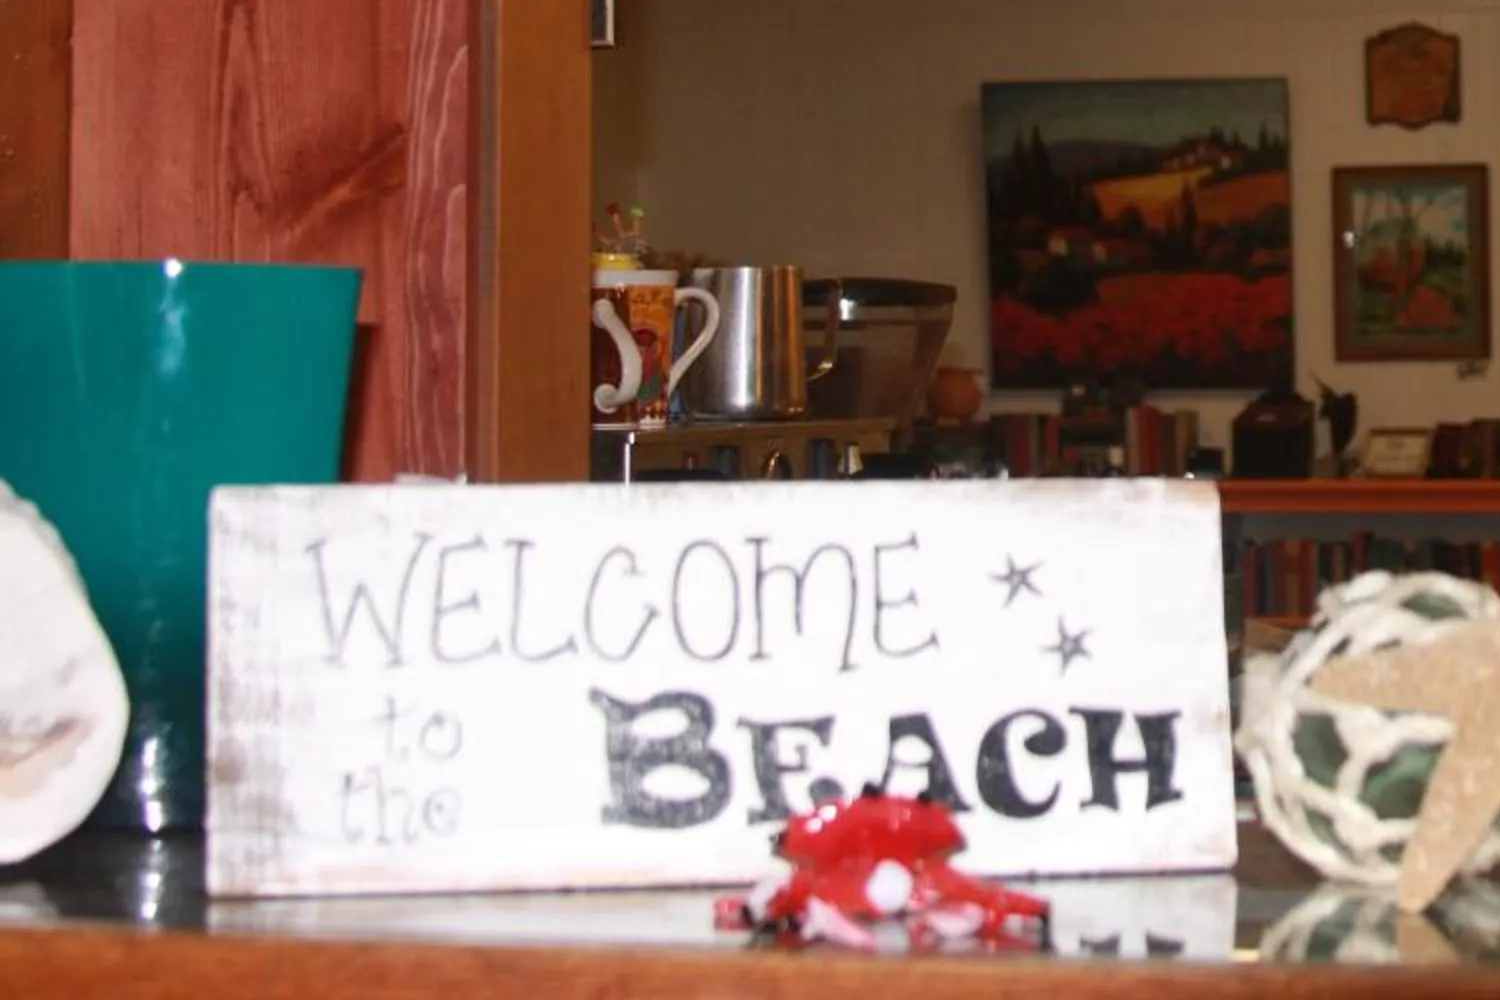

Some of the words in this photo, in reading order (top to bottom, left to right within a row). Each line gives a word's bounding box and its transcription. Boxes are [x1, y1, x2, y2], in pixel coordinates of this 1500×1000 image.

[305, 532, 941, 673] WELCOME
[371, 692, 464, 762] to
[589, 687, 1184, 829] BEACH
[338, 764, 463, 847] the
